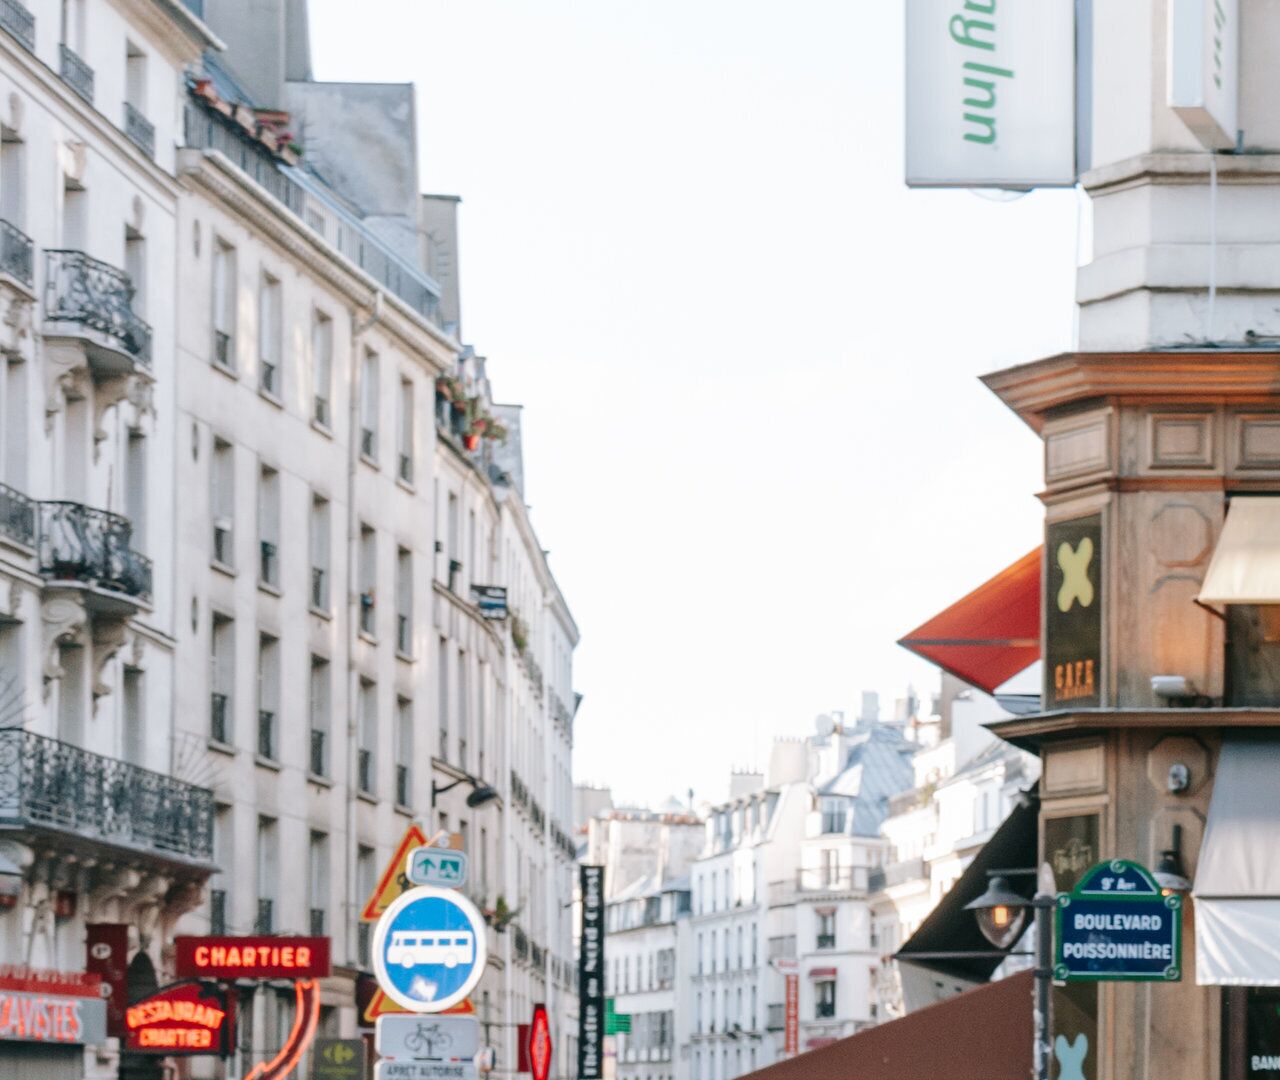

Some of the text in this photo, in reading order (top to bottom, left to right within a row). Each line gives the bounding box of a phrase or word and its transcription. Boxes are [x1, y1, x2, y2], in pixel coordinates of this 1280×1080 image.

[1073, 913, 1163, 931] BOULEVARD
[194, 946, 311, 968] CHARTIER
[1062, 940, 1173, 960] POISSONNIÈRE
[126, 1001, 226, 1029] RESTAURANT
[139, 1028, 212, 1047] CHARTIER
